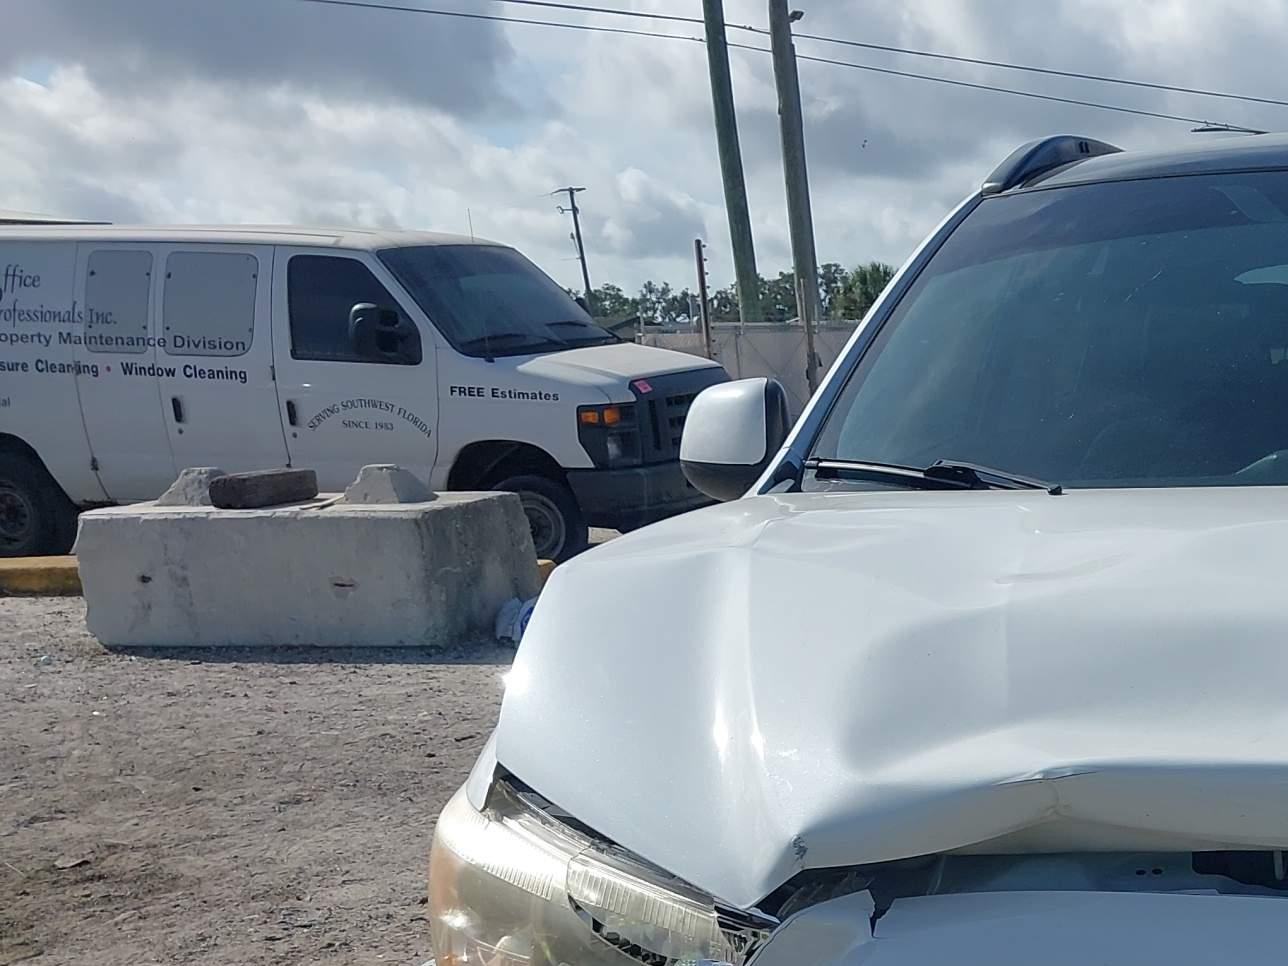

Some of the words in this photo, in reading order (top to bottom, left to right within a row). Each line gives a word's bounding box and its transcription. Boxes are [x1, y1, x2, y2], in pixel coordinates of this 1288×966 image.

[0, 264, 41, 295] ffice
[89, 308, 117, 325] Inc.
[58, 331, 167, 348] Maintenance
[173, 335, 247, 351] Division
[120, 361, 176, 378] Window
[183, 364, 248, 384] Cleaning
[450, 386, 485, 397] FREE
[491, 387, 560, 401] Estimates
[308, 403, 340, 431] SERVING
[340, 398, 395, 413] SOUTHWEST
[397, 407, 432, 438] FLORIDA
[342, 419, 370, 429] SINCE
